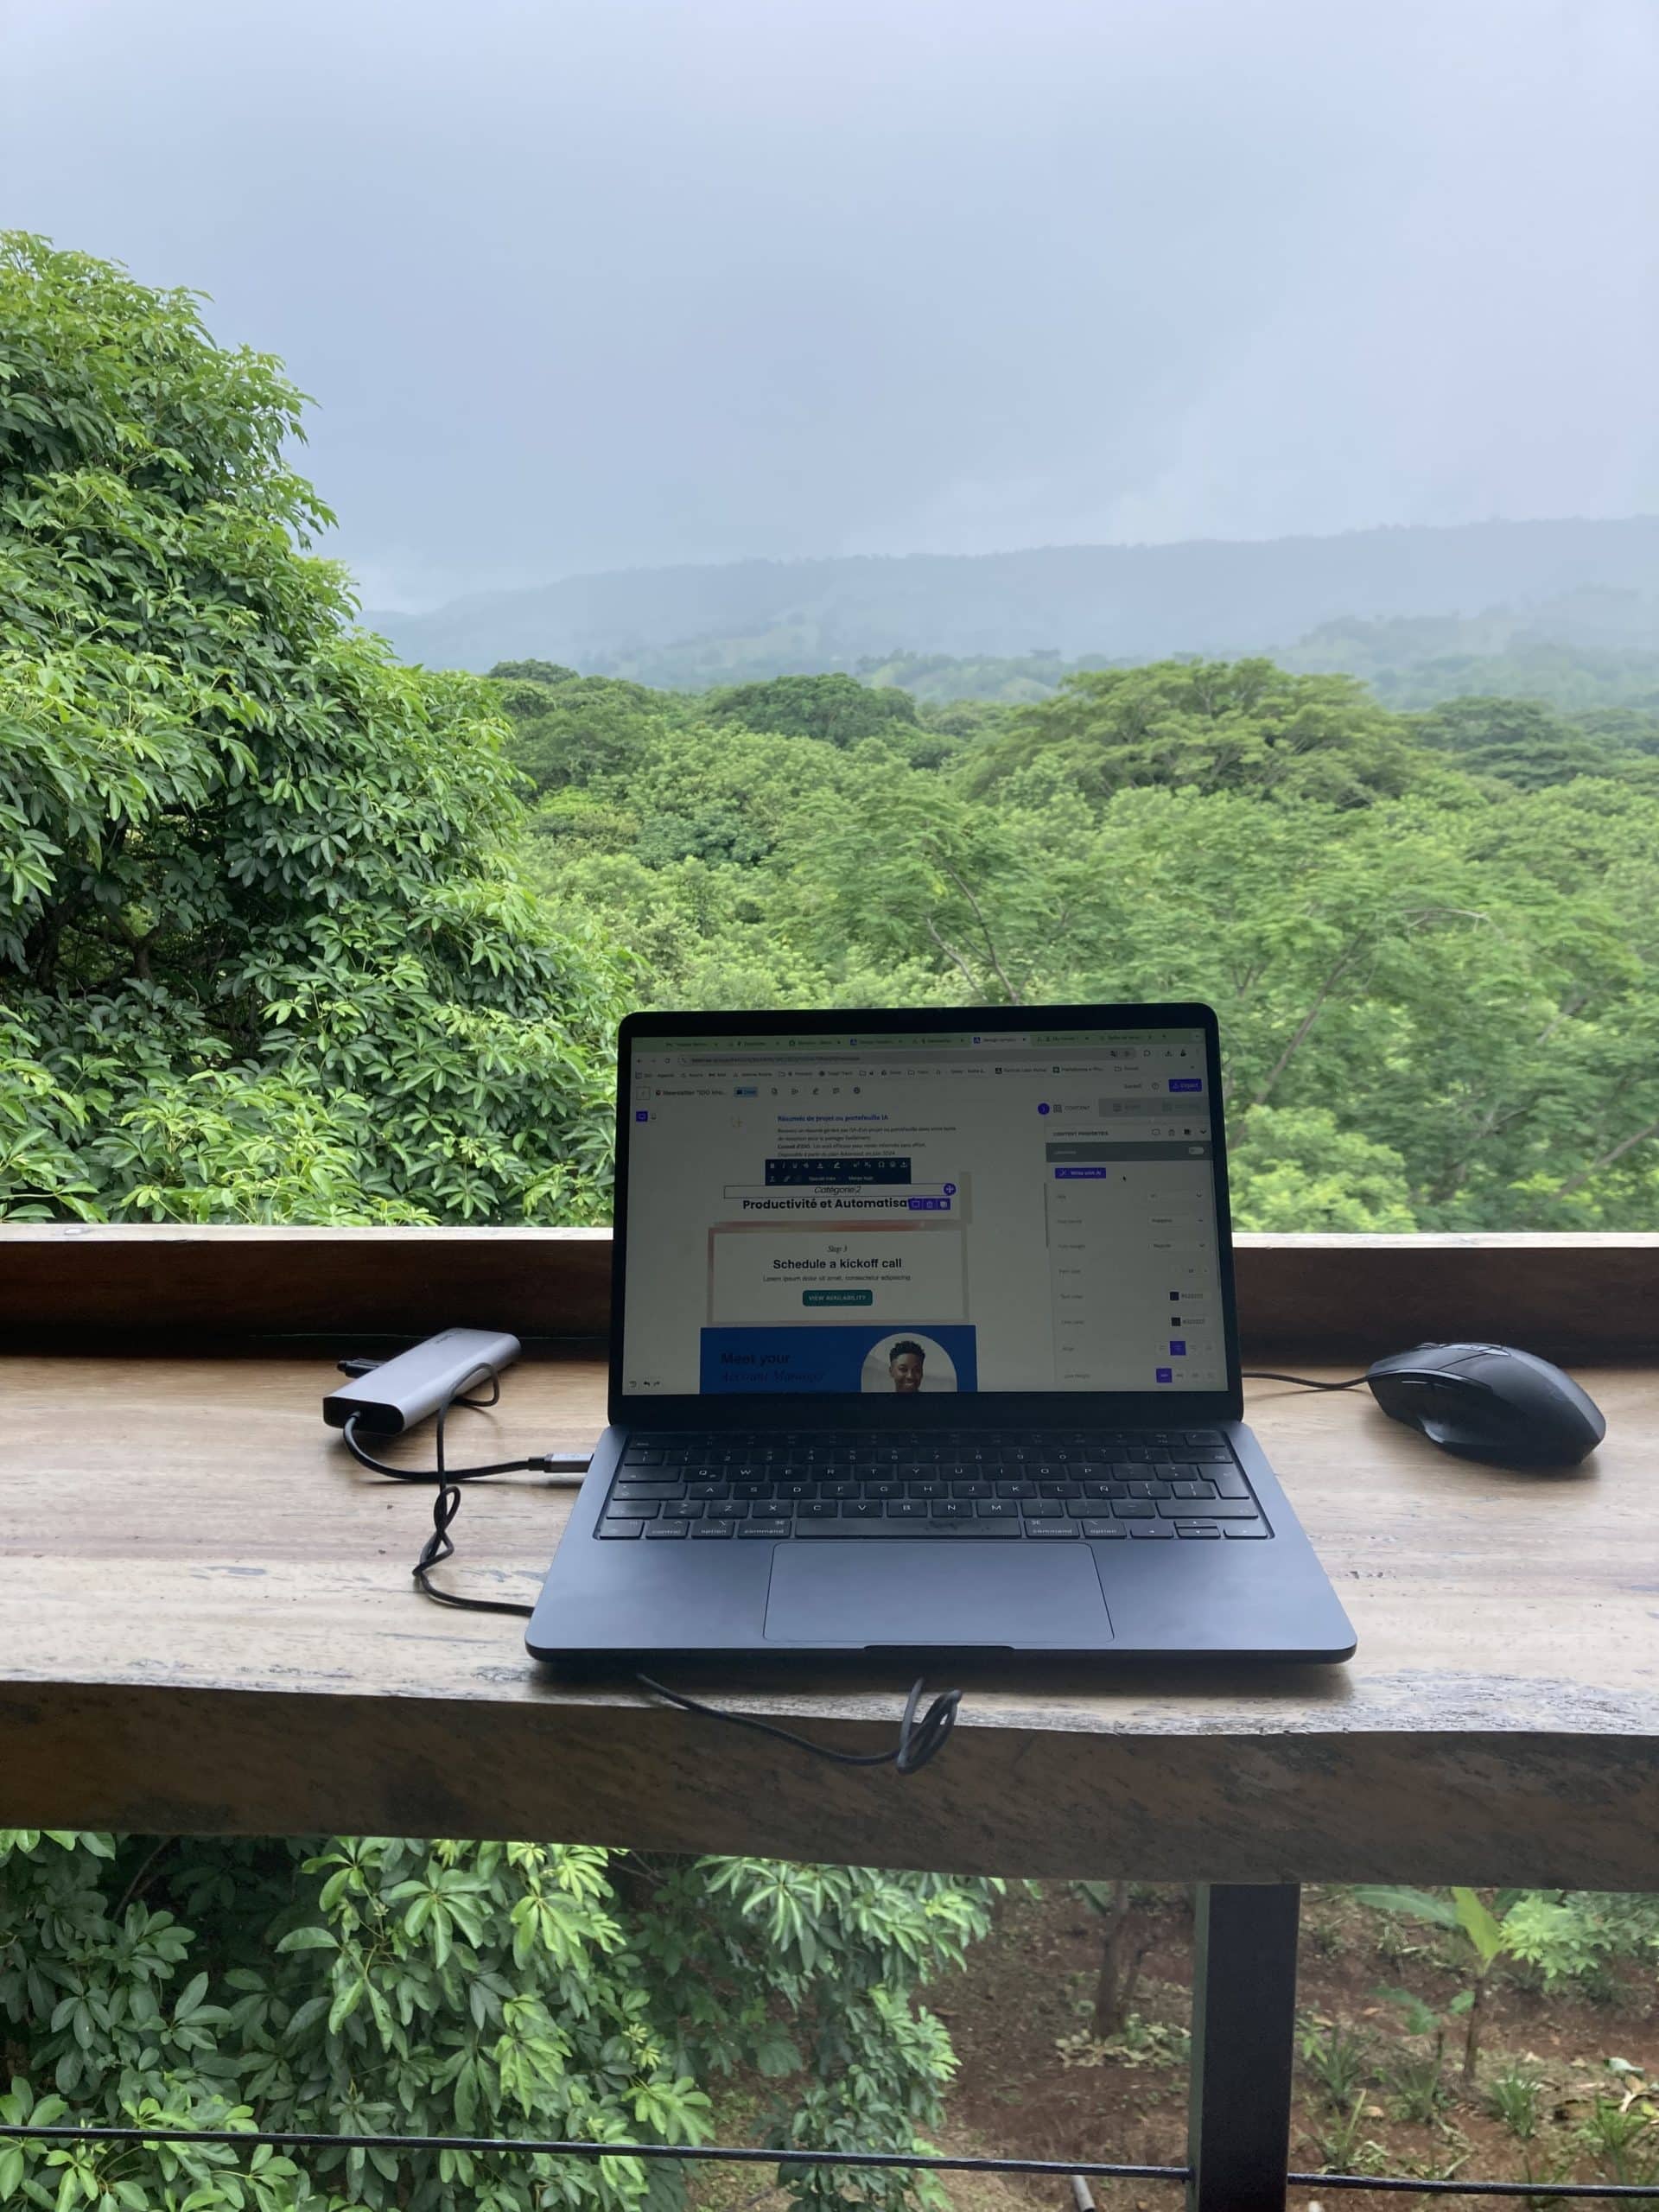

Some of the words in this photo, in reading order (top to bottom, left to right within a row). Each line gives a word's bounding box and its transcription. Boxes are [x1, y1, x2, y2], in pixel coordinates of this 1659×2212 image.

[743, 1198, 817, 1211] Productivité
[820, 1199, 836, 1210] et
[836, 1197, 908, 1209] Automatisa
[826, 1244, 841, 1255] Step
[772, 1259, 826, 1269] Schedule
[839, 1258, 879, 1268] kickoff
[881, 1257, 902, 1268] call
[783, 1274, 802, 1283] ipsum
[721, 1352, 755, 1364] Meet
[760, 1354, 791, 1367] your
